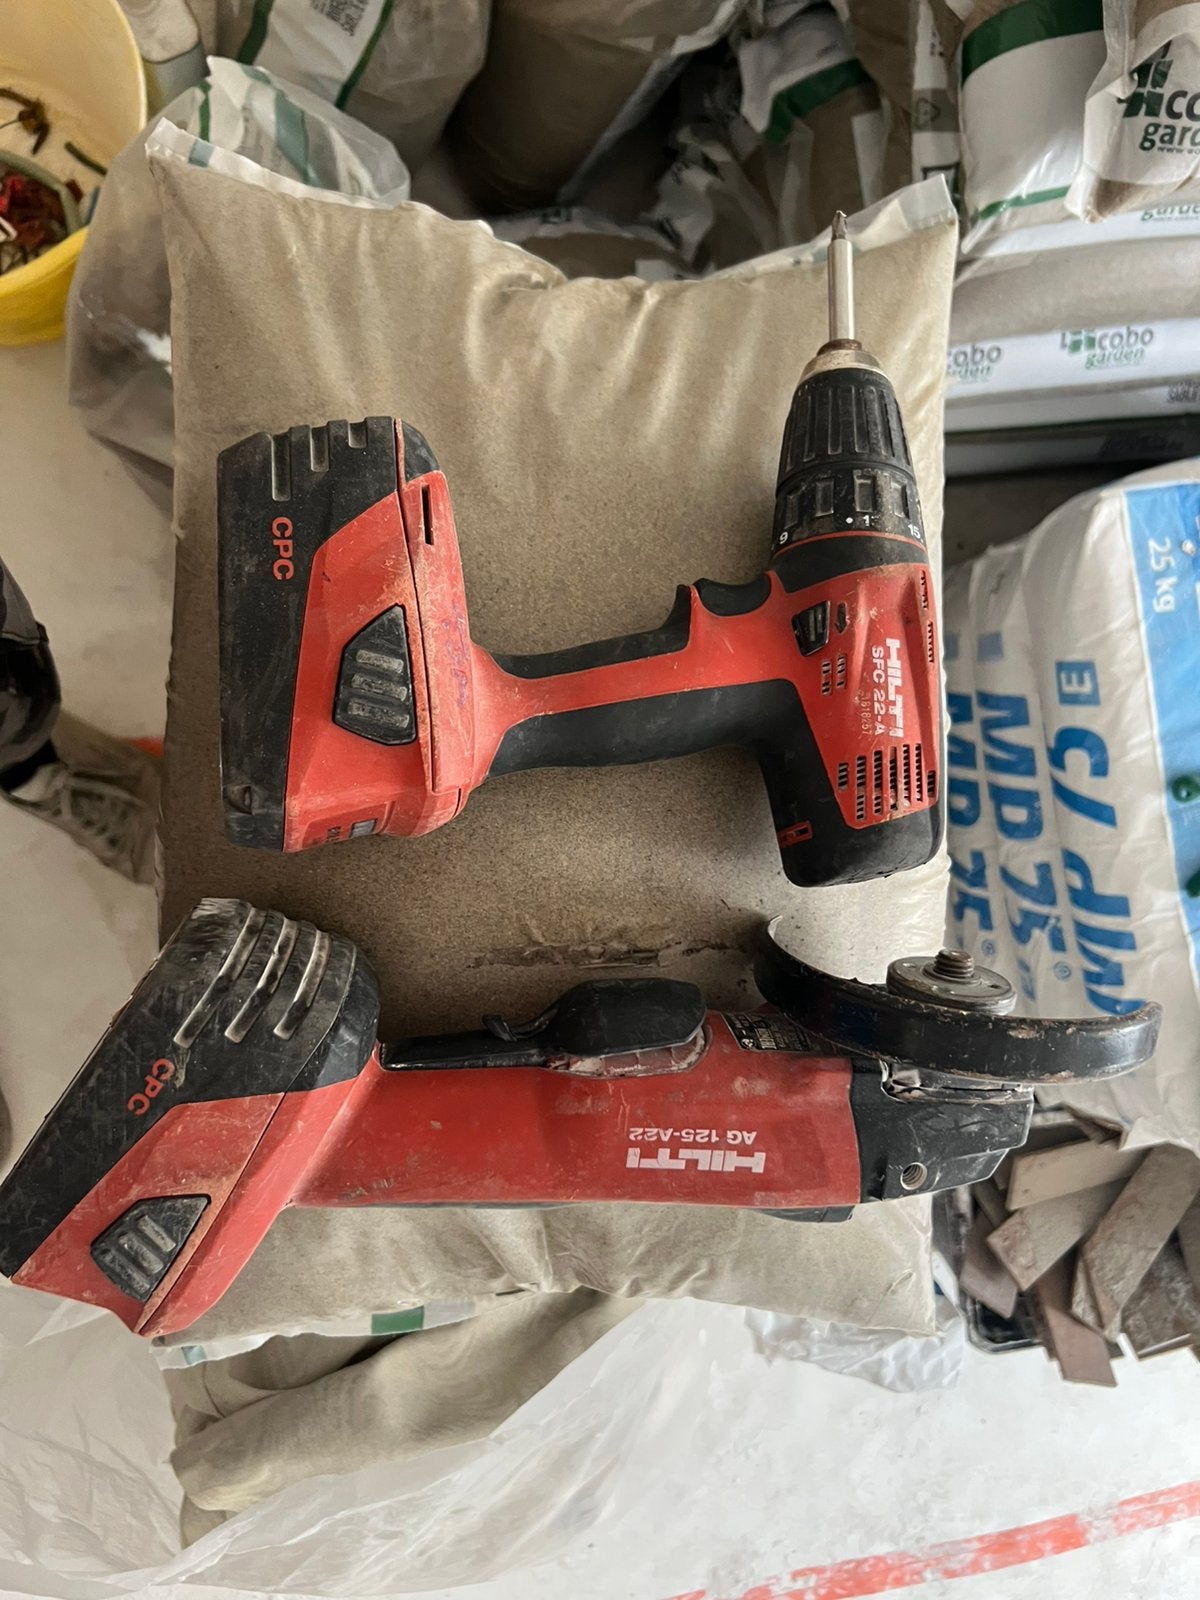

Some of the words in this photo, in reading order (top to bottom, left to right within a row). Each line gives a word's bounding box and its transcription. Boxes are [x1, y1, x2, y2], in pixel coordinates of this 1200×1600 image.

[1098, 325, 1154, 351] cobo
[1084, 346, 1145, 370] garden
[779, 531, 789, 545] 9
[907, 523, 921, 539] 15
[271, 515, 294, 581] CPC
[1148, 538, 1176, 572] 25
[1153, 576, 1179, 613] kg
[872, 645, 886, 684] SFC
[885, 637, 904, 738] HILTI
[873, 688, 887, 736] 22-A
[127, 1057, 176, 1116] CPC
[628, 1127, 720, 1144] 125-A22
[726, 1130, 757, 1145] AG
[626, 1147, 766, 1174] HILTI
